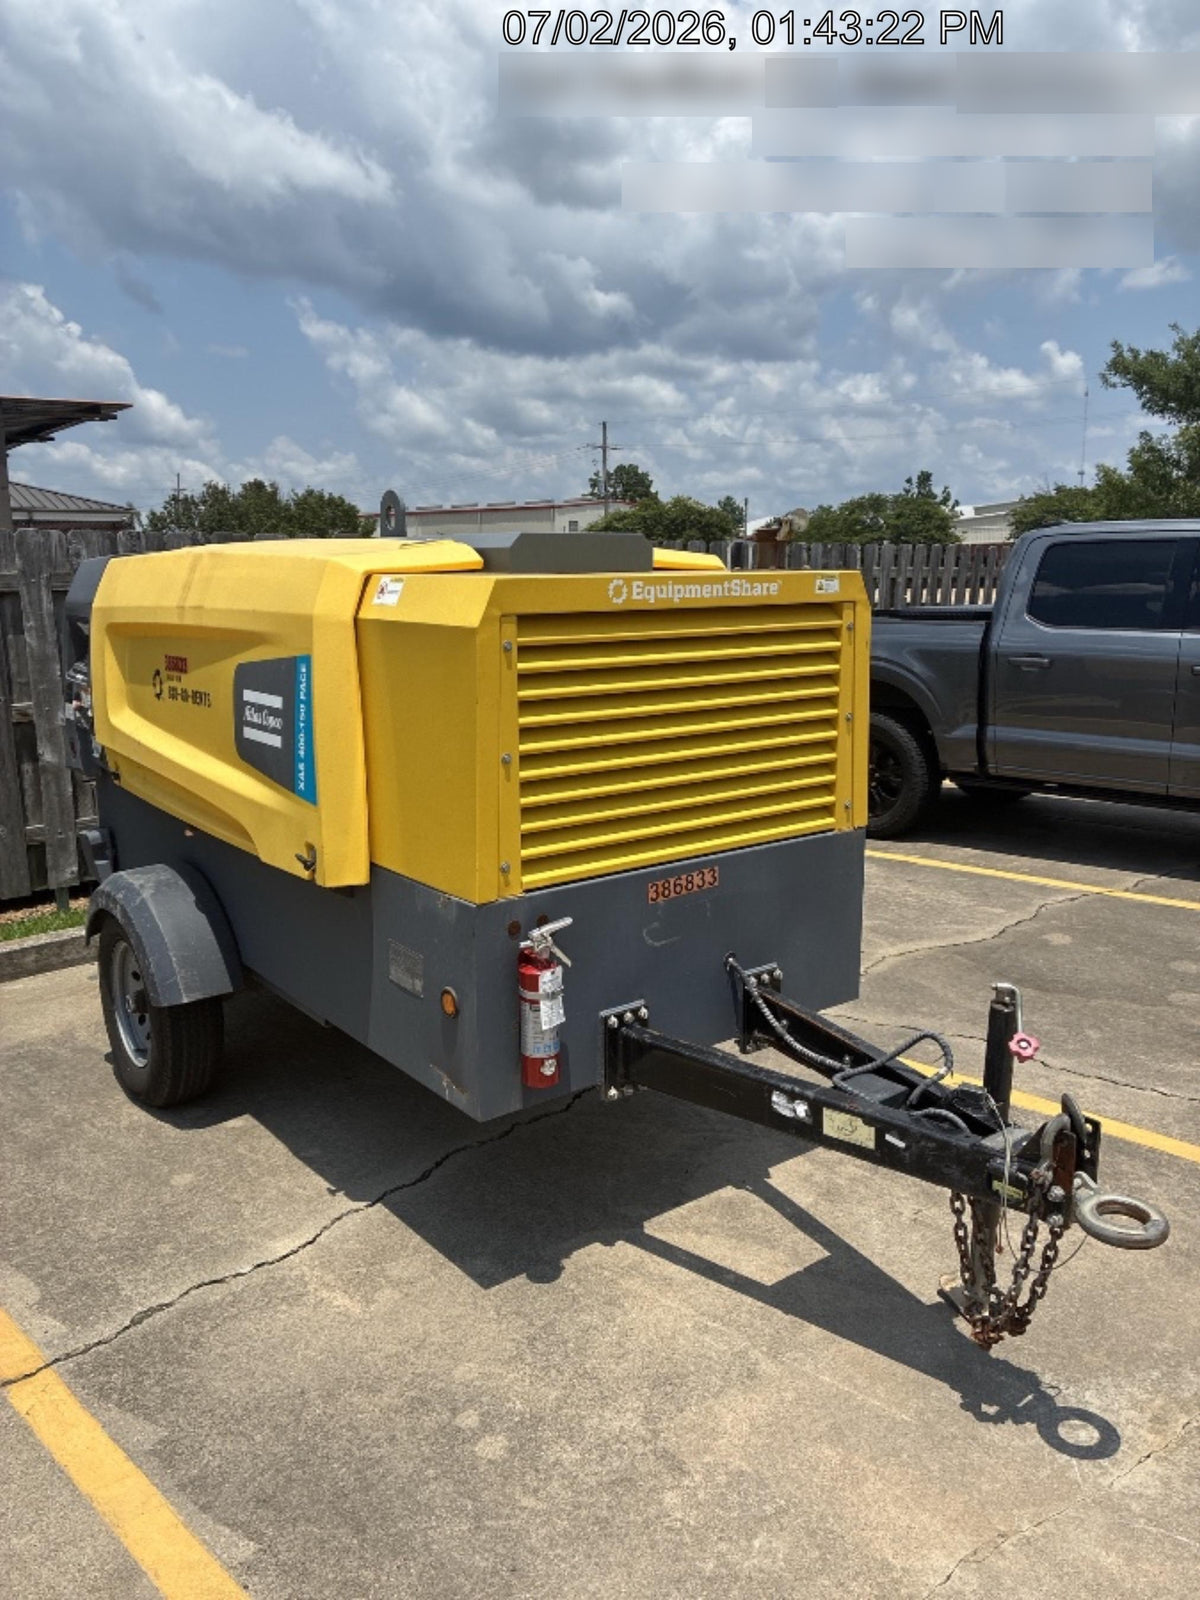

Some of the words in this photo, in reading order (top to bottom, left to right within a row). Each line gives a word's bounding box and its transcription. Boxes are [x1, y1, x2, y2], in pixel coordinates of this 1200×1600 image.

[631, 578, 779, 603] EquipmentShare
[299, 663, 307, 701] PACE
[243, 704, 262, 725] Atlas
[262, 709, 283, 731] Copco
[649, 868, 718, 902] 386833
